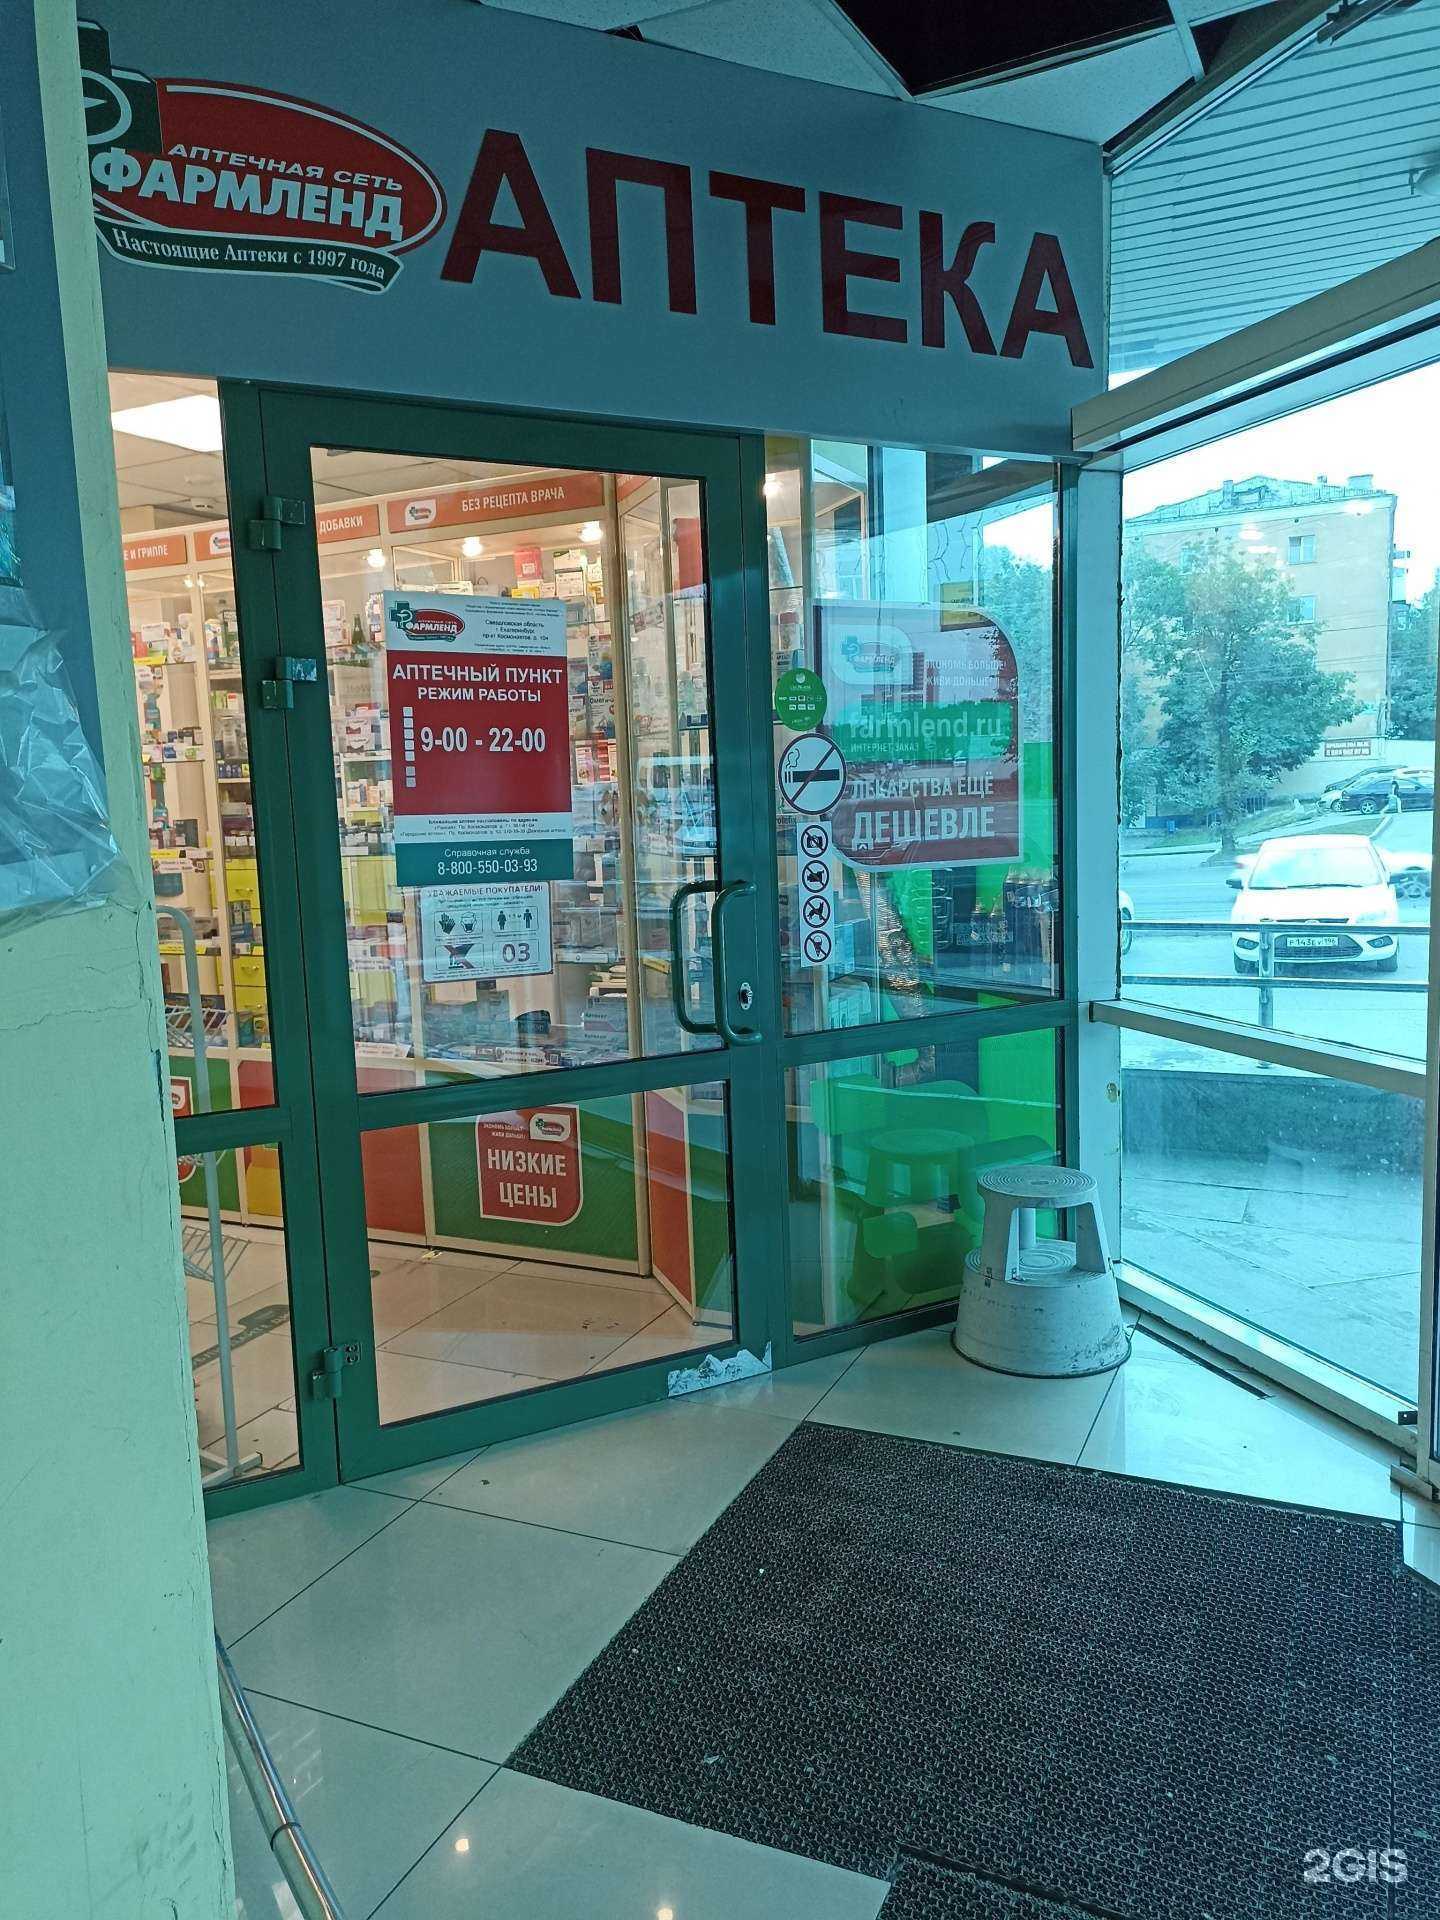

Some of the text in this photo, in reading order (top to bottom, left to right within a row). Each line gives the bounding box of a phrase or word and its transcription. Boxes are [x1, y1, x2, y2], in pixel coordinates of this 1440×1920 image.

[168, 143, 403, 191] АПТЕЧНАЯ СЕТЬ
[90, 146, 404, 242] ФАРМЛЕНД
[111, 226, 386, 280] Настоящие Аптеки с 1997 года
[439, 127, 1094, 369] АПТЕКА
[461, 486, 566, 513] БЕЗ РЕЦЕПТА ВРАЧА
[319, 515, 364, 536] ДОБАВКИ
[137, 544, 169, 560] ГРИППЕ
[405, 621, 458, 633] ФАРМЛЕНД
[392, 663, 563, 684] АПТЕЧНЫЙ ПУНКТ
[417, 686, 541, 702] РЕЖИМ РАБОТЫ
[420, 726, 468, 752] 9-00
[488, 727, 546, 752] 22-00
[850, 771, 994, 800] ЛЕКАРСТВА ЕЩЁ
[851, 806, 996, 850] ДЕШЕВЛЕ
[444, 846, 530, 859] Справочная служба
[437, 858, 538, 876] 8-800-550-03-93
[502, 942, 531, 964] 03
[487, 1148, 567, 1177] НИЗКИЕ
[499, 1181, 558, 1209] ЦЕНЫ
